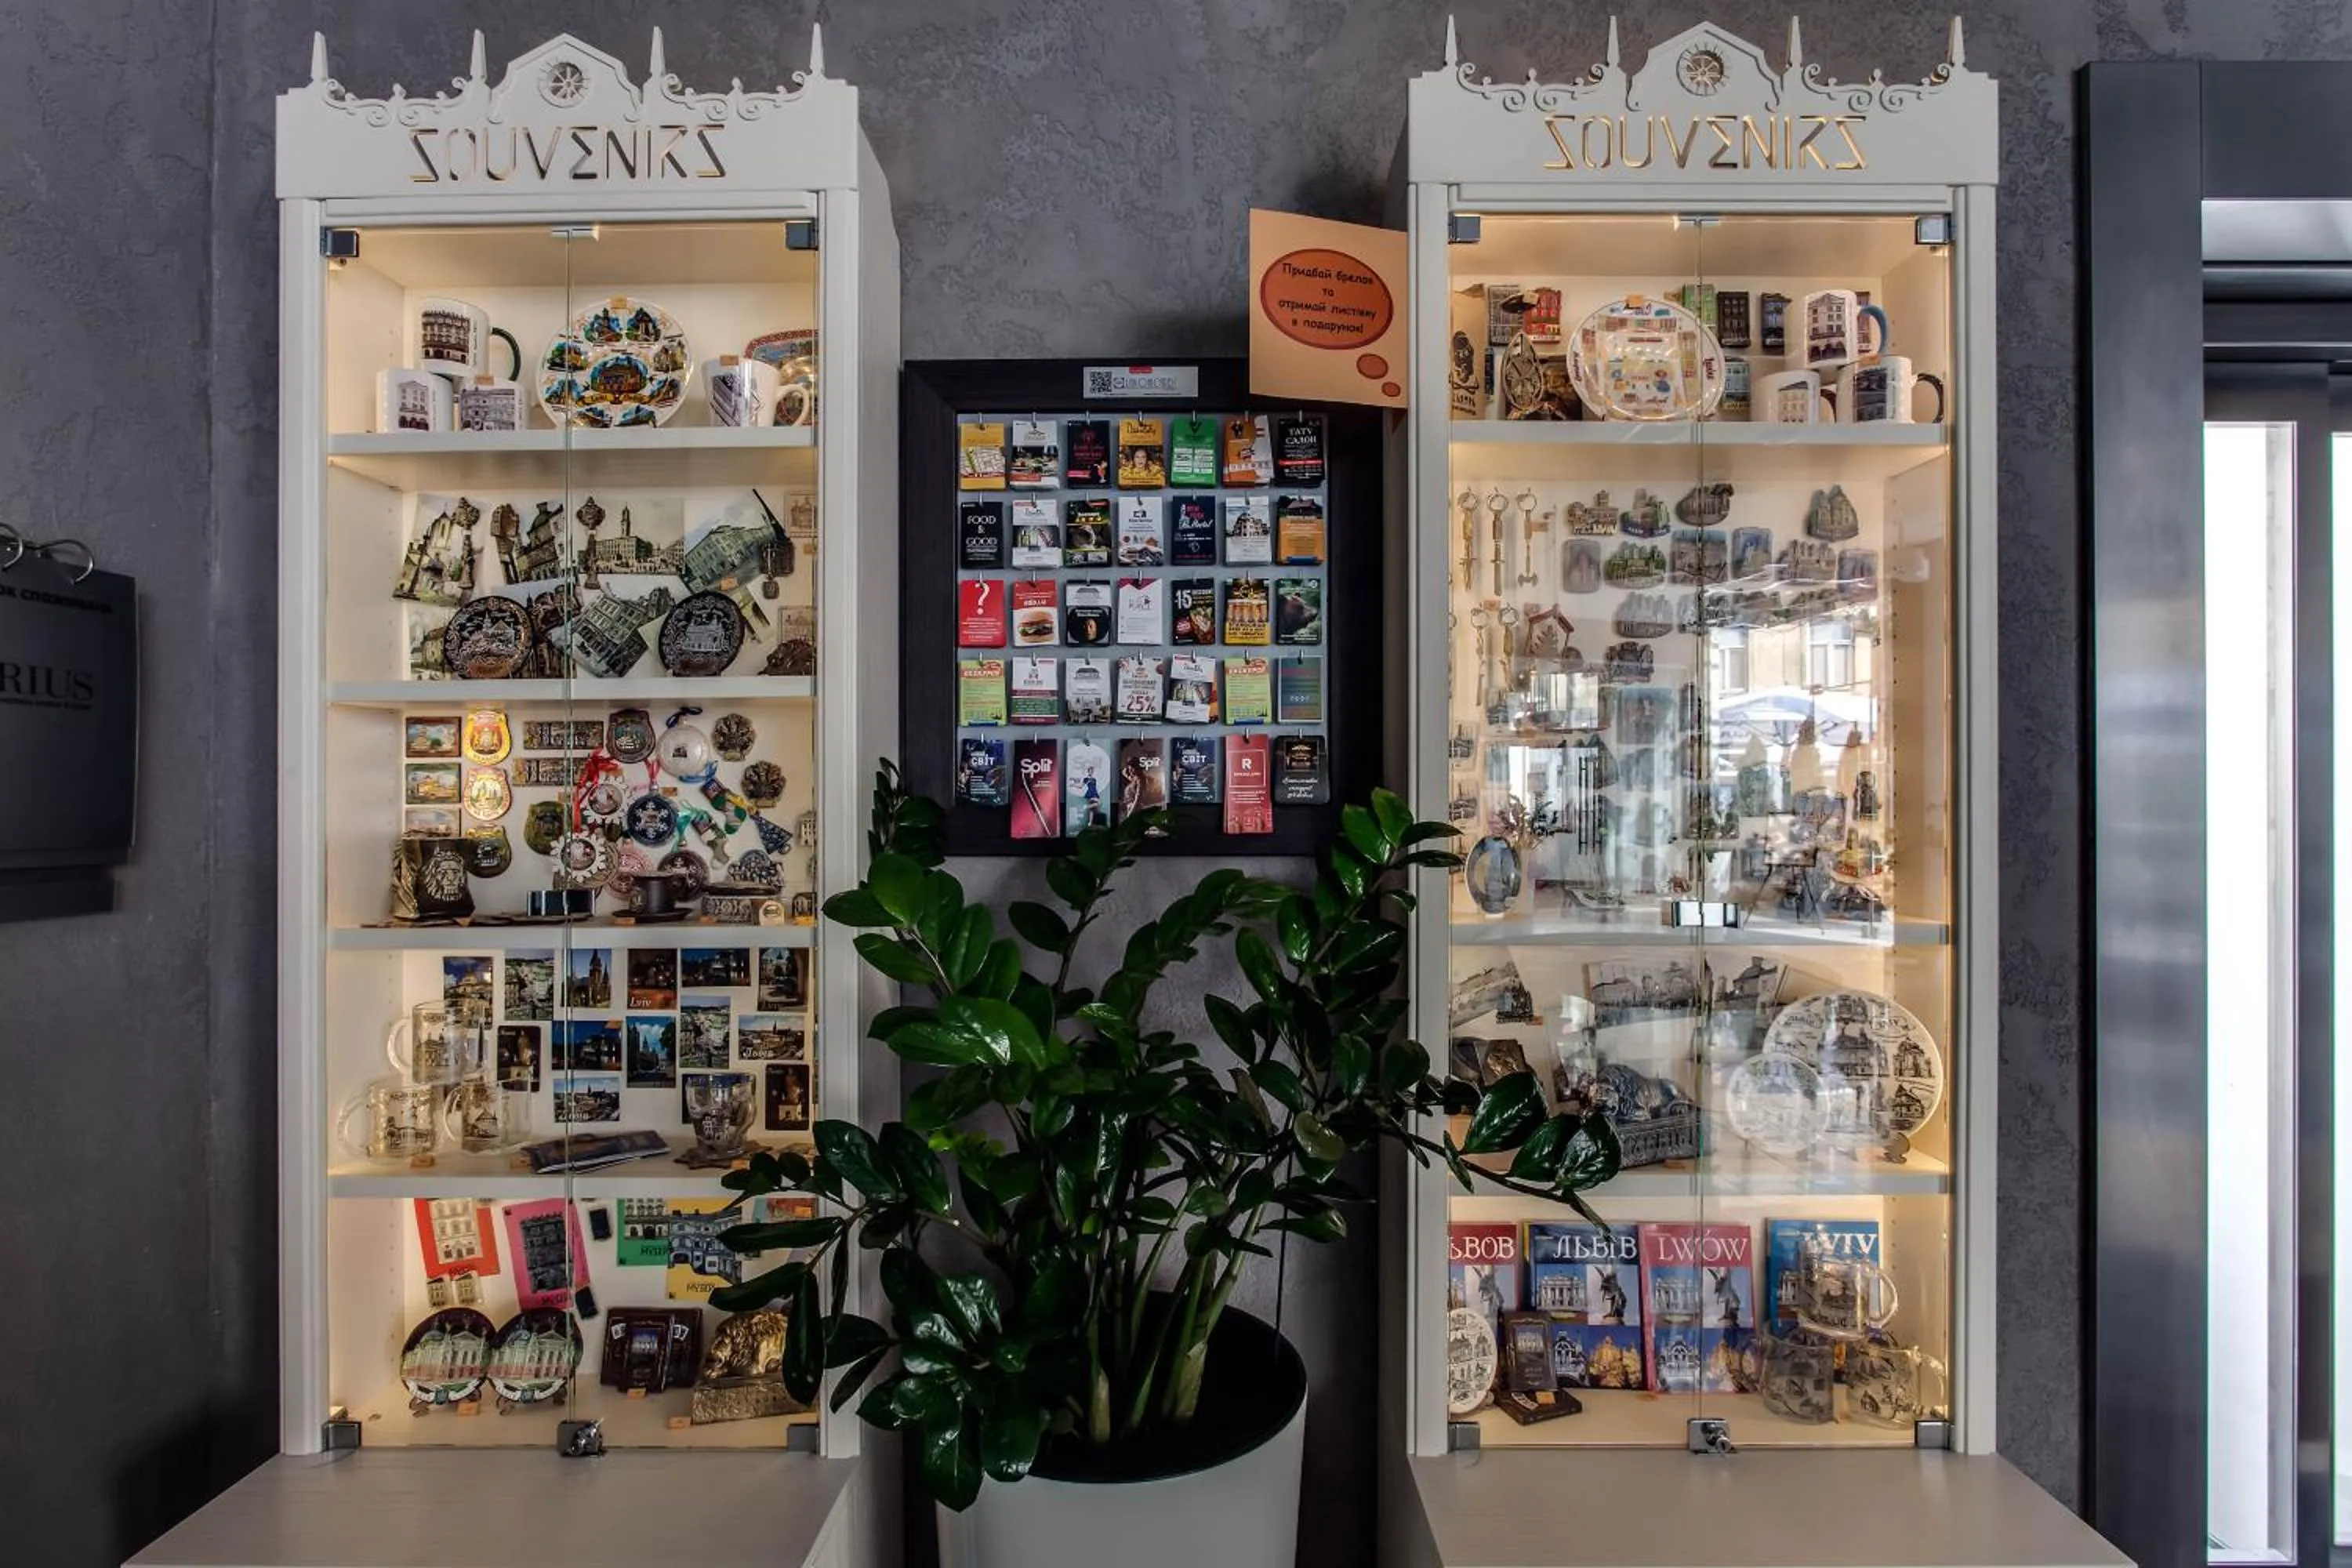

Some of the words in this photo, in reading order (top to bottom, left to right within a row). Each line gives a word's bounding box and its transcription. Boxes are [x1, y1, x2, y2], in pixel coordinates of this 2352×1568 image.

[1283, 263, 1332, 279] Придбай
[1322, 288, 1334, 297] та
[1279, 299, 1327, 312] отримай
[1285, 436, 1317, 445] САЛОН
[967, 514, 996, 524] FOOD
[630, 996, 652, 1007] Lviv
[1447, 1236, 1515, 1259] ЬВОВ
[1658, 1229, 1750, 1261] LWÓW
